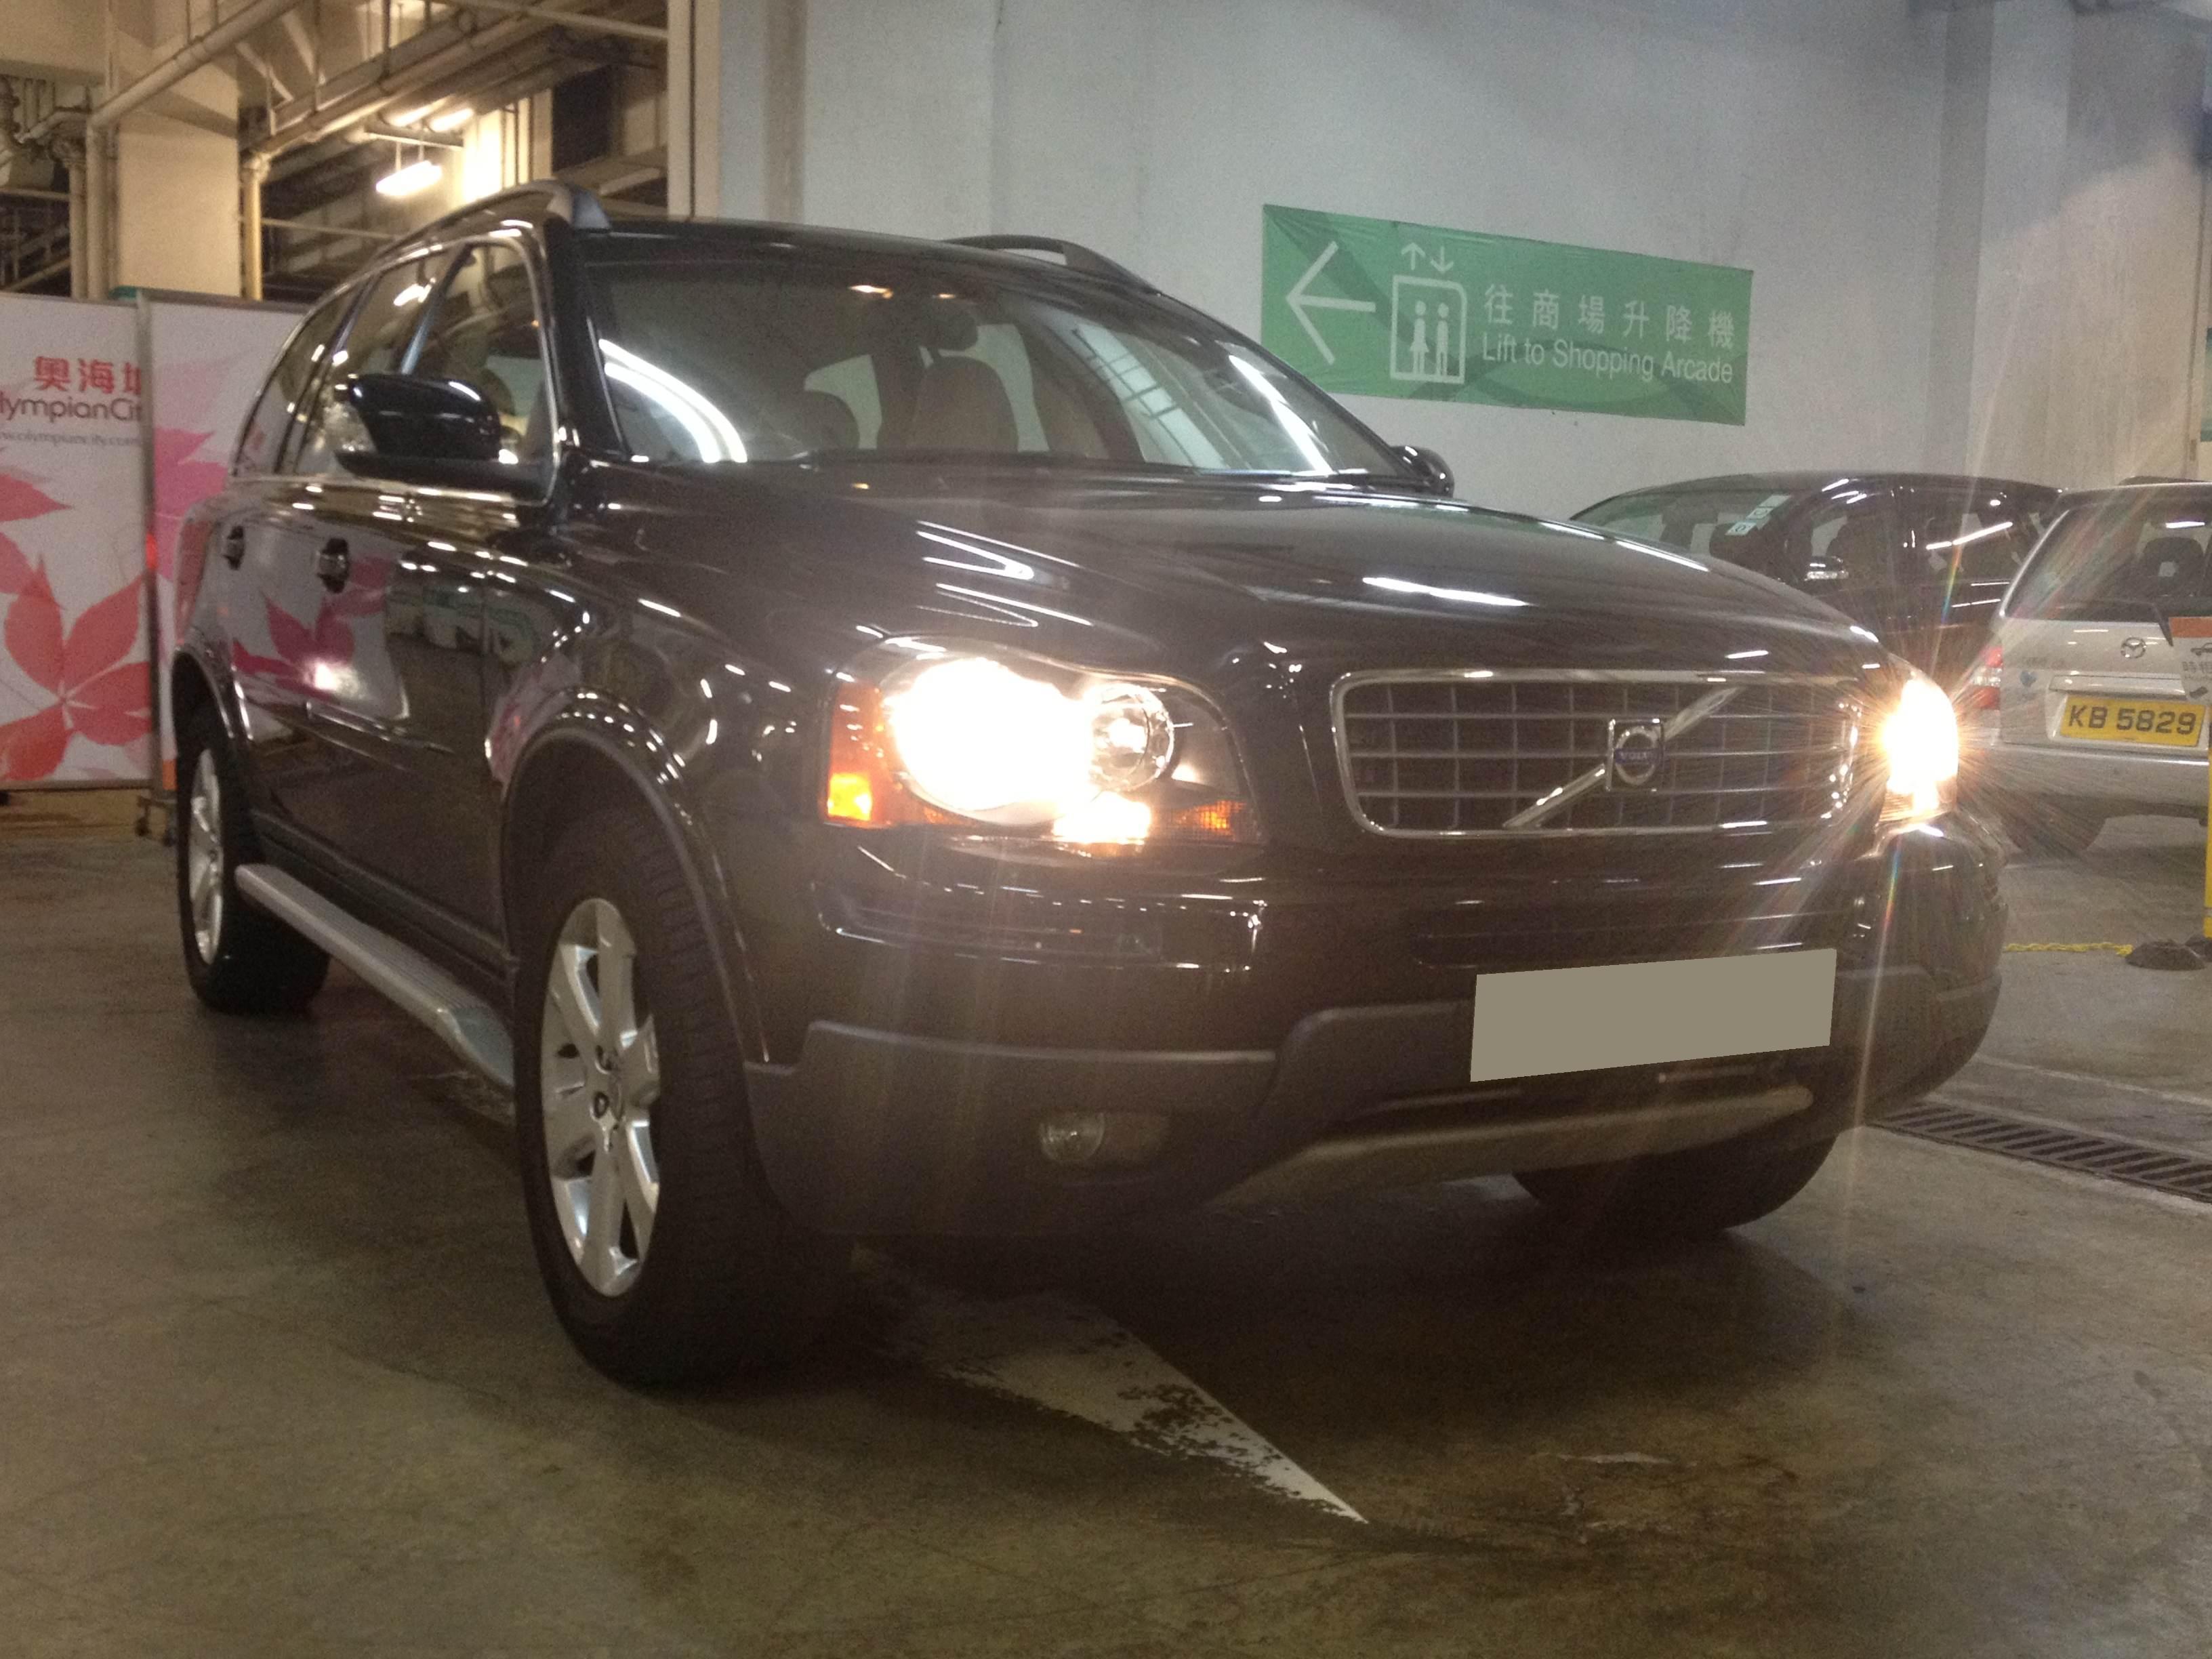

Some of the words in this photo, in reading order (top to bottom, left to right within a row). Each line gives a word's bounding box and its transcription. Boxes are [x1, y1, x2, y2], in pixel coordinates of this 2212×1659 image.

[1483, 283, 1735, 350] 往商場升降機
[1481, 332, 1517, 364] Lift
[1524, 338, 1544, 365] to
[1553, 339, 1654, 382] Shopping
[1661, 350, 1733, 384] Arcade
[0, 390, 141, 424] lympianCit
[2068, 705, 2108, 729] KB
[2116, 708, 2197, 735] 5829
